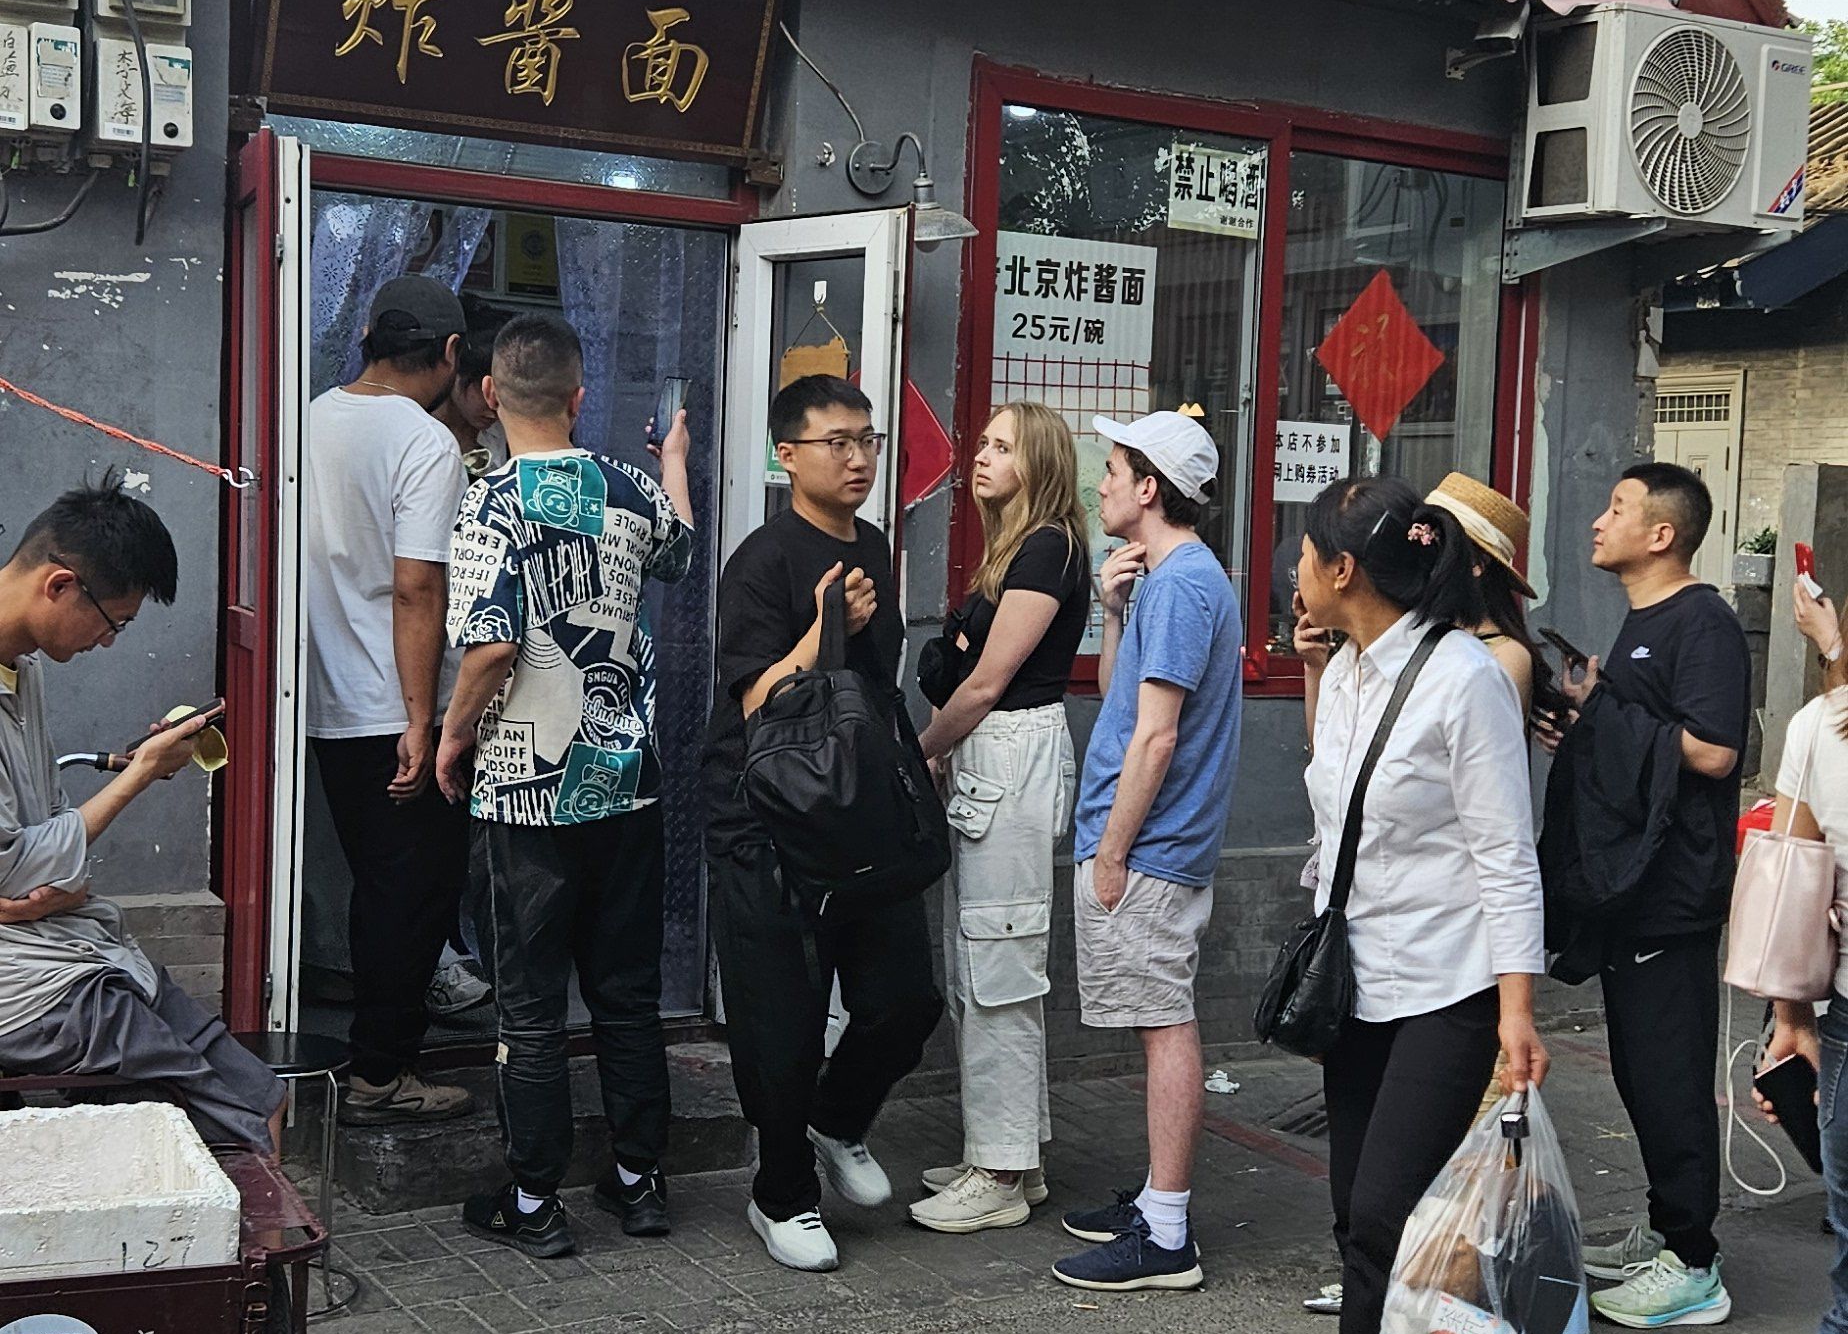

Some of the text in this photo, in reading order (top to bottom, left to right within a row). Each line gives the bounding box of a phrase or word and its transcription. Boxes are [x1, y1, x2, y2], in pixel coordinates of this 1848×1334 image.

[1780, 63, 1806, 75] GREE
[994, 253, 1146, 306] 北京炸酱面
[1011, 312, 1105, 345] 25元/碗
